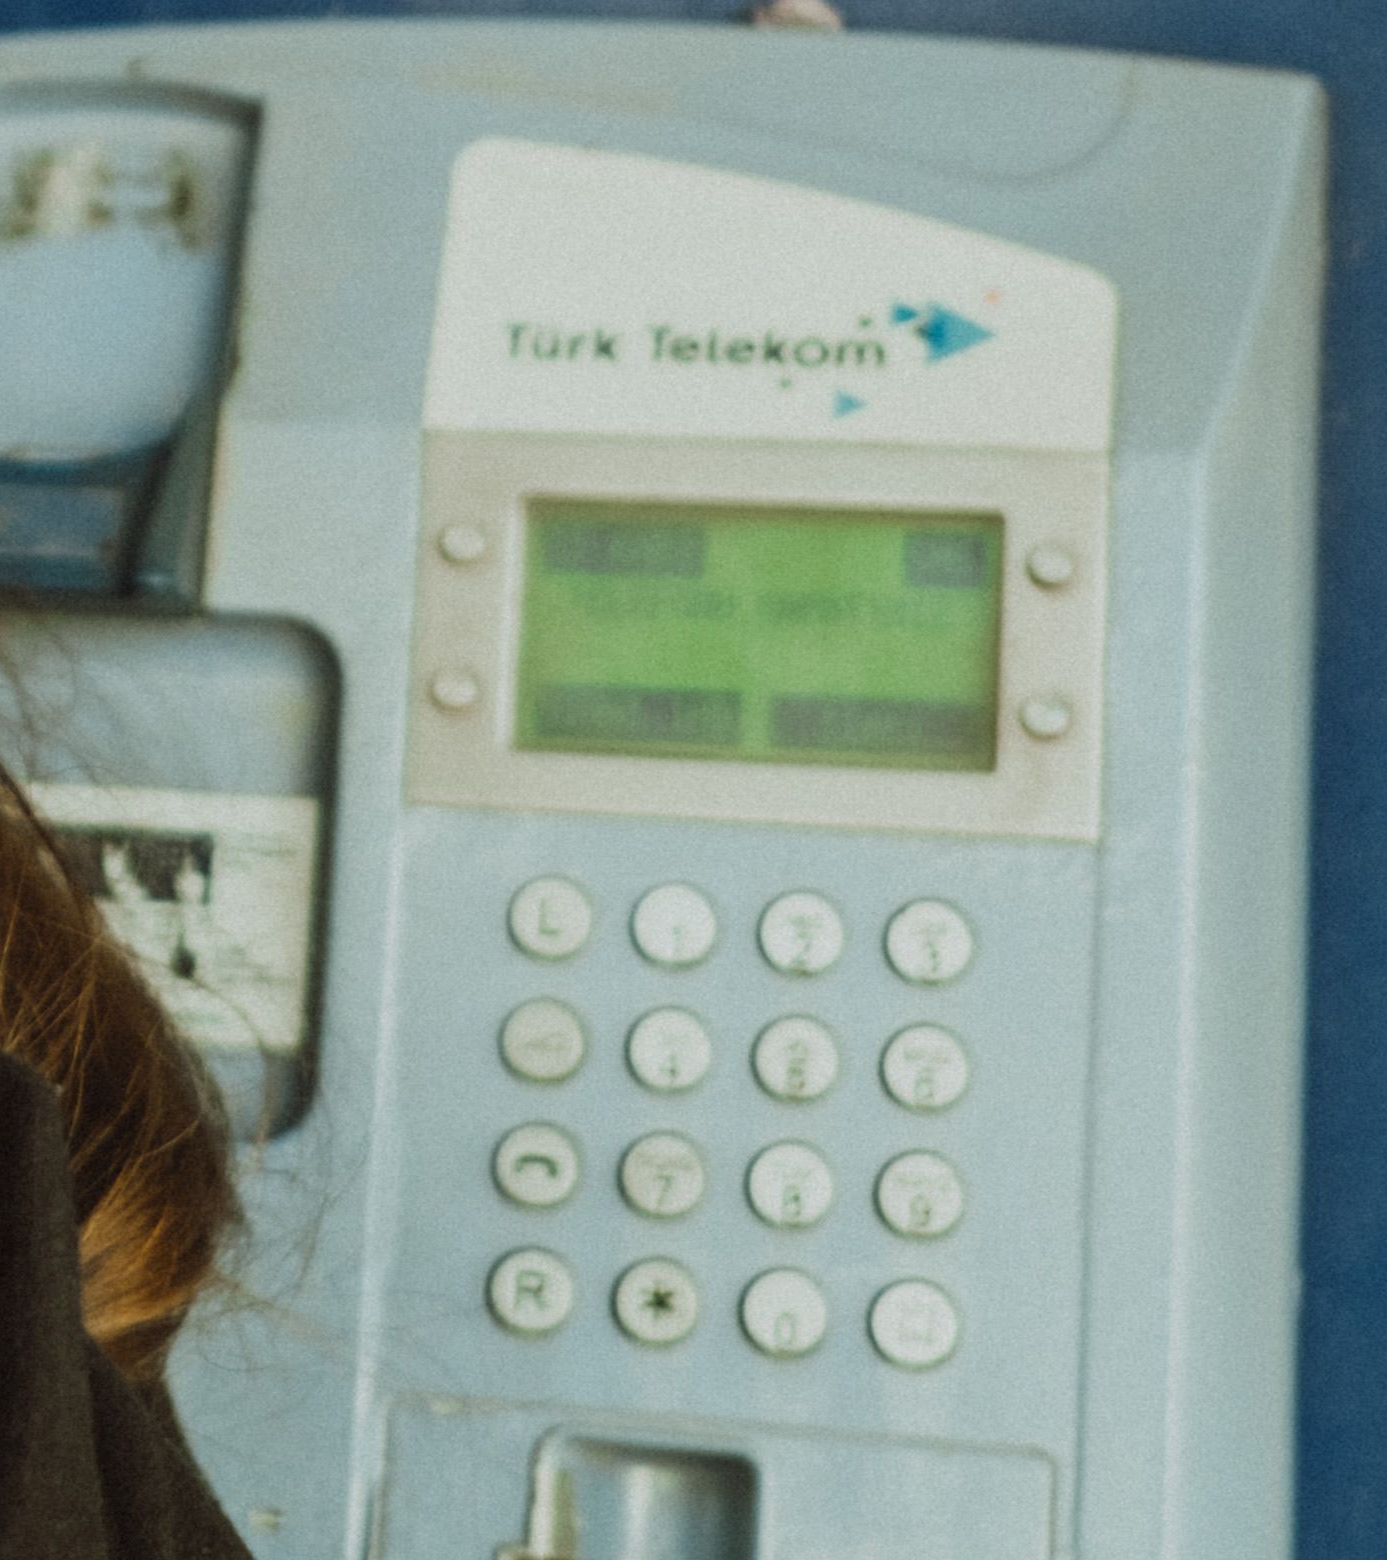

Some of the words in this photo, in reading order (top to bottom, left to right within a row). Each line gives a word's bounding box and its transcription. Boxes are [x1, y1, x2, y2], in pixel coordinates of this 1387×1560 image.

[506, 320, 619, 363] Türk
[646, 323, 888, 369] Telekom
[512, 1268, 549, 1314] R
